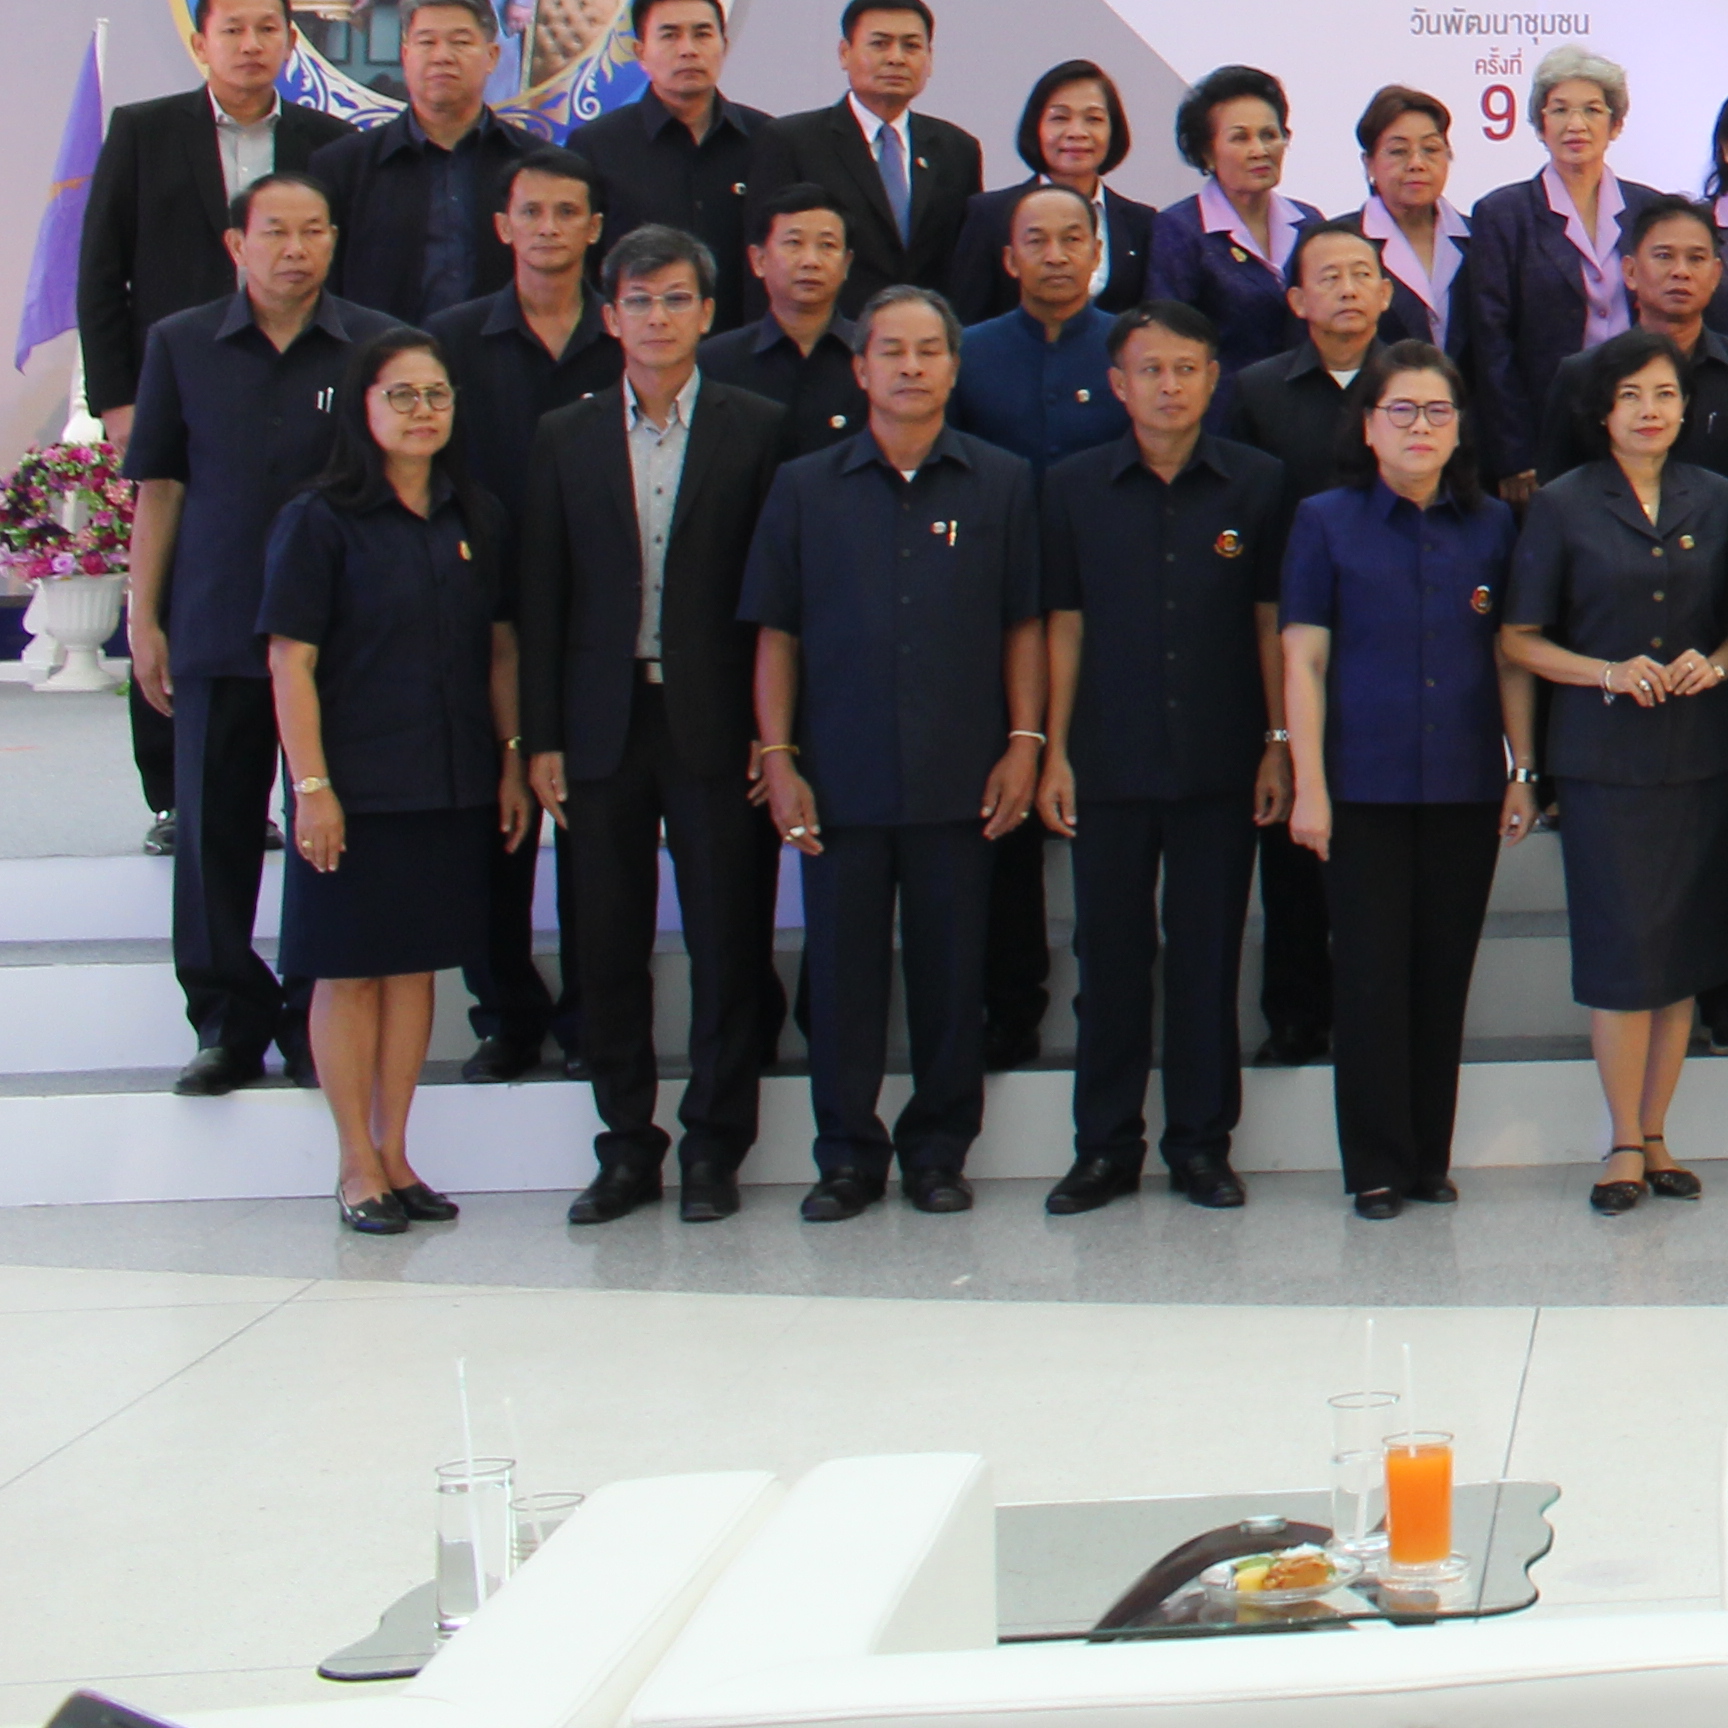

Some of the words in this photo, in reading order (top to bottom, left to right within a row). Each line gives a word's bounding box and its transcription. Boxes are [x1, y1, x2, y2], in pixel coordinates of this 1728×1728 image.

[1410, 7, 1590, 45] วันพัฒนาชุมชน
[1474, 47, 1522, 75] ครั้งที่
[1480, 84, 1516, 142] 9
